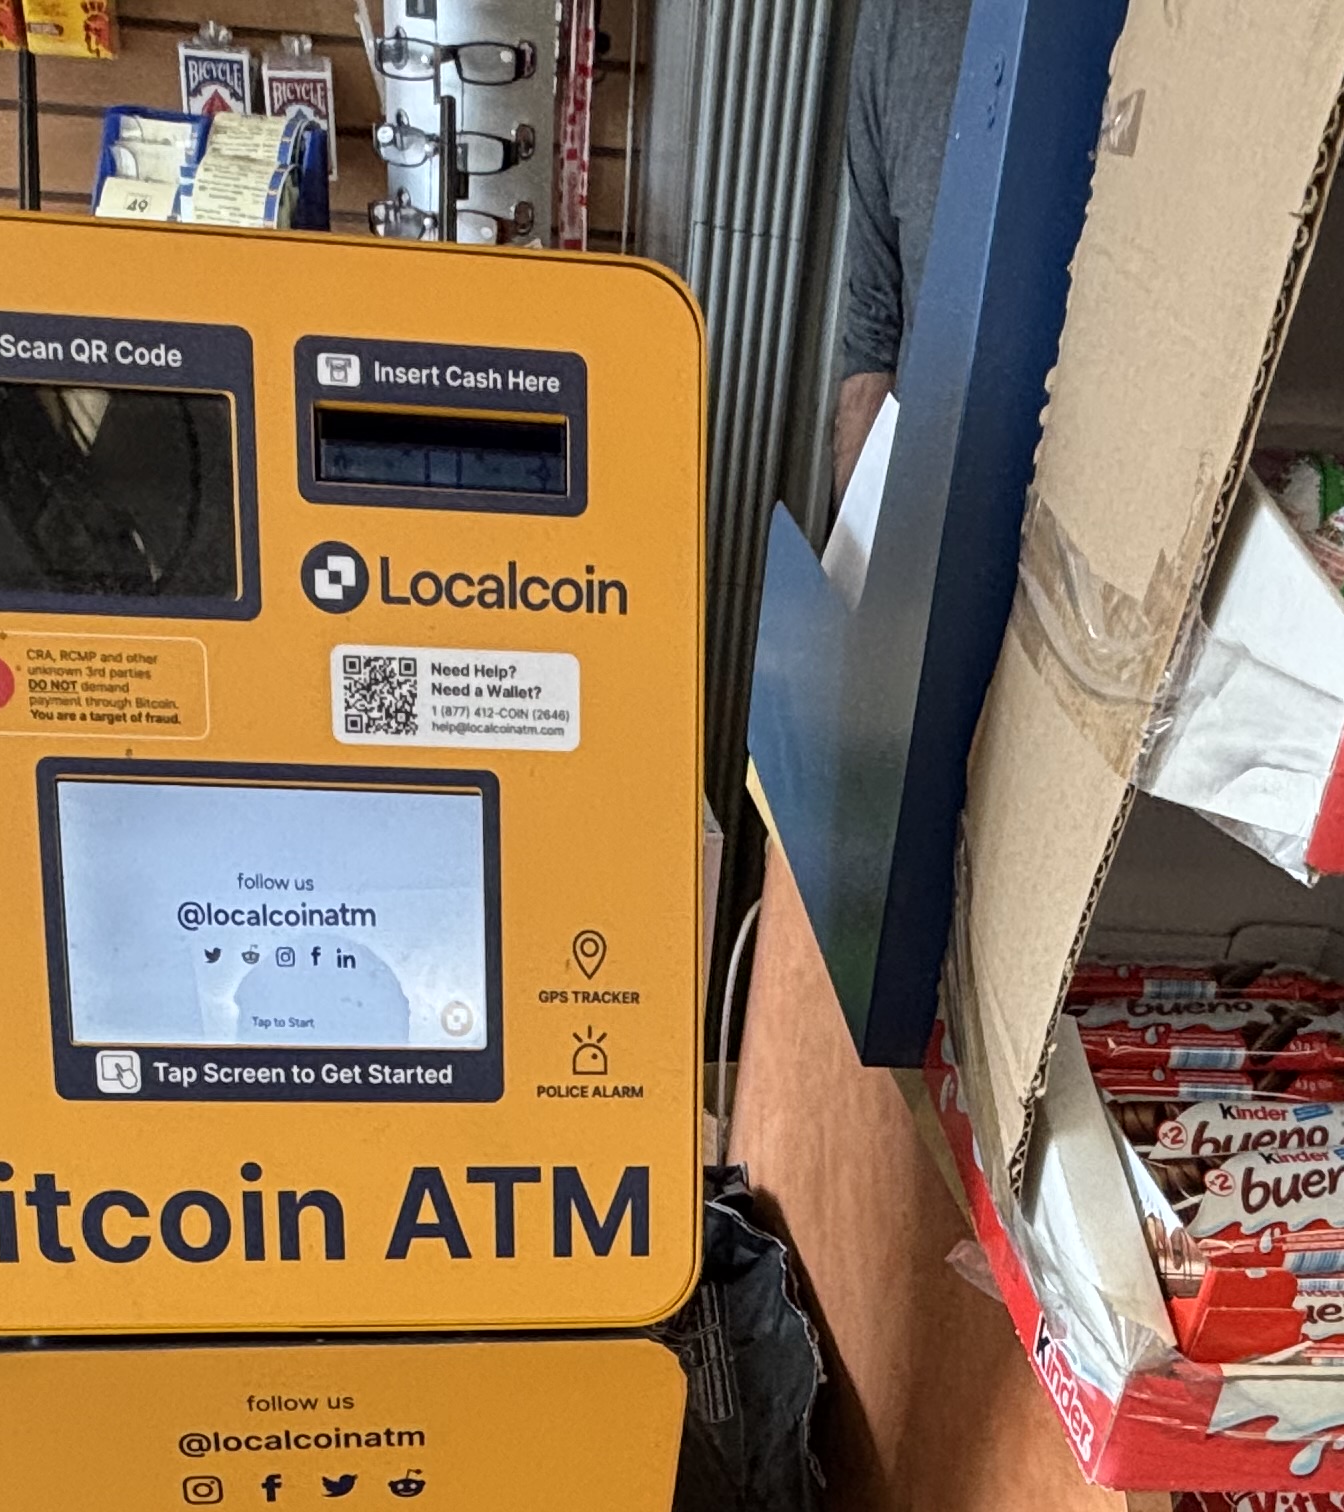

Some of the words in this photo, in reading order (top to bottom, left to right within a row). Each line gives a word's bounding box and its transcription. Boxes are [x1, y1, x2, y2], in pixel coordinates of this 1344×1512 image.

[188, 60, 242, 92] BICYCLE
[272, 81, 326, 113] BICYCLE
[0, 335, 62, 361] Scan
[70, 338, 109, 364] QR
[114, 341, 183, 367] Code
[374, 361, 440, 388] Insert
[445, 366, 503, 390] Cash
[508, 371, 561, 394] Here
[378, 556, 629, 616] Localcoin
[26, 649, 56, 664] CRA,
[59, 650, 97, 663] RCMP
[100, 652, 123, 664] and
[126, 653, 159, 665] other
[27, 666, 83, 678] unknown
[86, 666, 106, 678] 3rd
[109, 667, 152, 681] parties
[431, 662, 470, 677] Need
[474, 664, 517, 681] Help?
[28, 679, 47, 691] DO
[50, 680, 78, 692] NOT
[81, 682, 130, 694] demand
[431, 682, 470, 697] Need
[474, 686, 483, 698] a
[487, 684, 542, 700] Wallet?
[29, 695, 82, 709] payment
[85, 696, 132, 711] through
[135, 697, 179, 710] Bitcoin.
[31, 709, 54, 721] You
[57, 711, 77, 722] are
[79, 713, 87, 722] a
[90, 711, 127, 725] target
[130, 711, 143, 723] of
[145, 711, 182, 725] fraud.
[431, 705, 437, 717] 1
[441, 705, 470, 719] (877)
[474, 706, 529, 720] 412-COIN
[532, 708, 570, 723] (2646)
[431, 721, 565, 736] help@localcoinatm.com
[237, 872, 290, 892] follow
[294, 876, 314, 892] us
[177, 901, 376, 931] @localcoinatm
[538, 990, 569, 1005] GPS
[572, 990, 640, 1005] TRACKER
[252, 1015, 272, 1030] Tap
[274, 1016, 286, 1029] to
[288, 1016, 314, 1029] Start
[154, 1062, 197, 1087] Tap
[203, 1062, 285, 1085] Screen
[292, 1064, 315, 1084] to
[321, 1062, 362, 1085] Get
[367, 1063, 452, 1085] Started
[537, 1083, 589, 1098] POLICE
[593, 1084, 644, 1099] ALARM
[1219, 1103, 1289, 1122] Kinder
[1191, 1120, 1330, 1156] bueno
[1260, 1148, 1331, 1165] Kinder
[384, 1165, 652, 1261] ATM
[246, 1395, 319, 1413] follow
[327, 1396, 355, 1410] us
[178, 1427, 426, 1458] @localcoinatm
